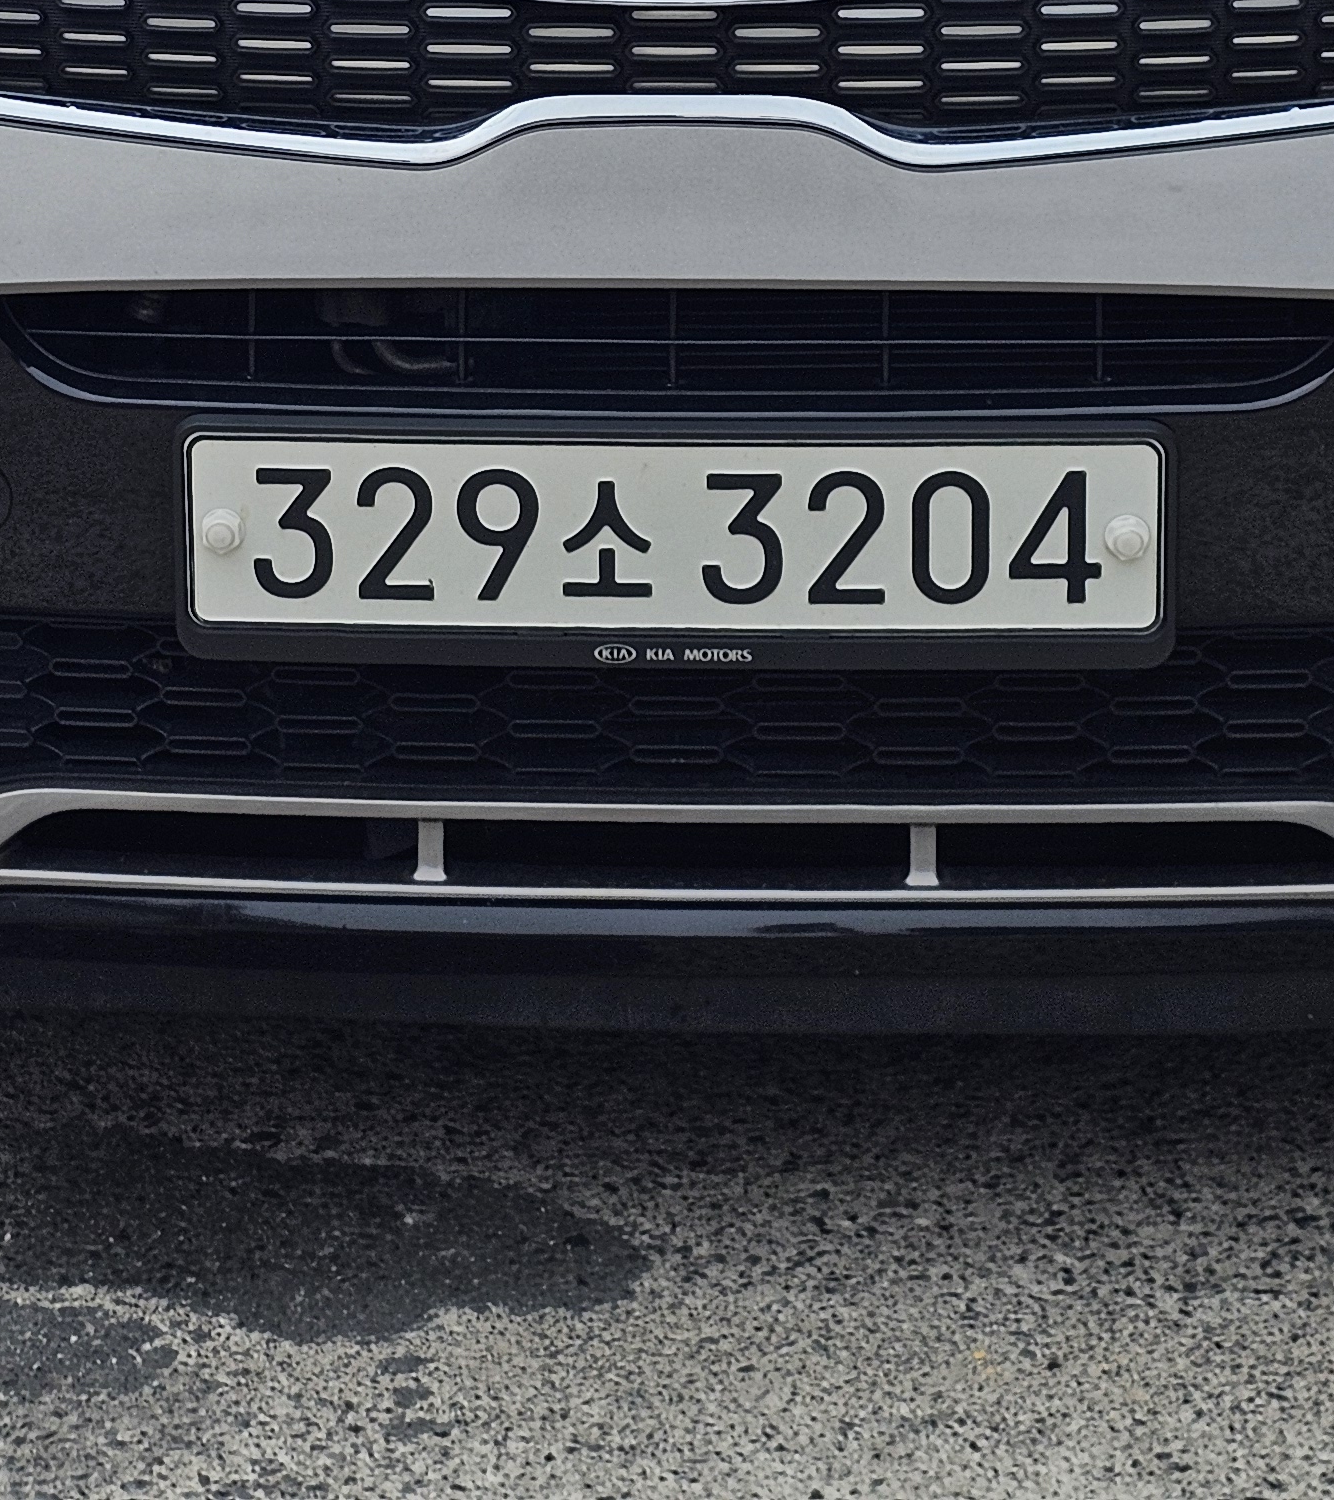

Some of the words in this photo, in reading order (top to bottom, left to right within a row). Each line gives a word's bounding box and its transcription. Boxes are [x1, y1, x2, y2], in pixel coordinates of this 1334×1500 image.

[253, 467, 653, 601] 329소
[701, 470, 1102, 605] 3204
[601, 648, 630, 660] KIA
[646, 648, 675, 661] KIA
[684, 648, 753, 662] MOTORS
